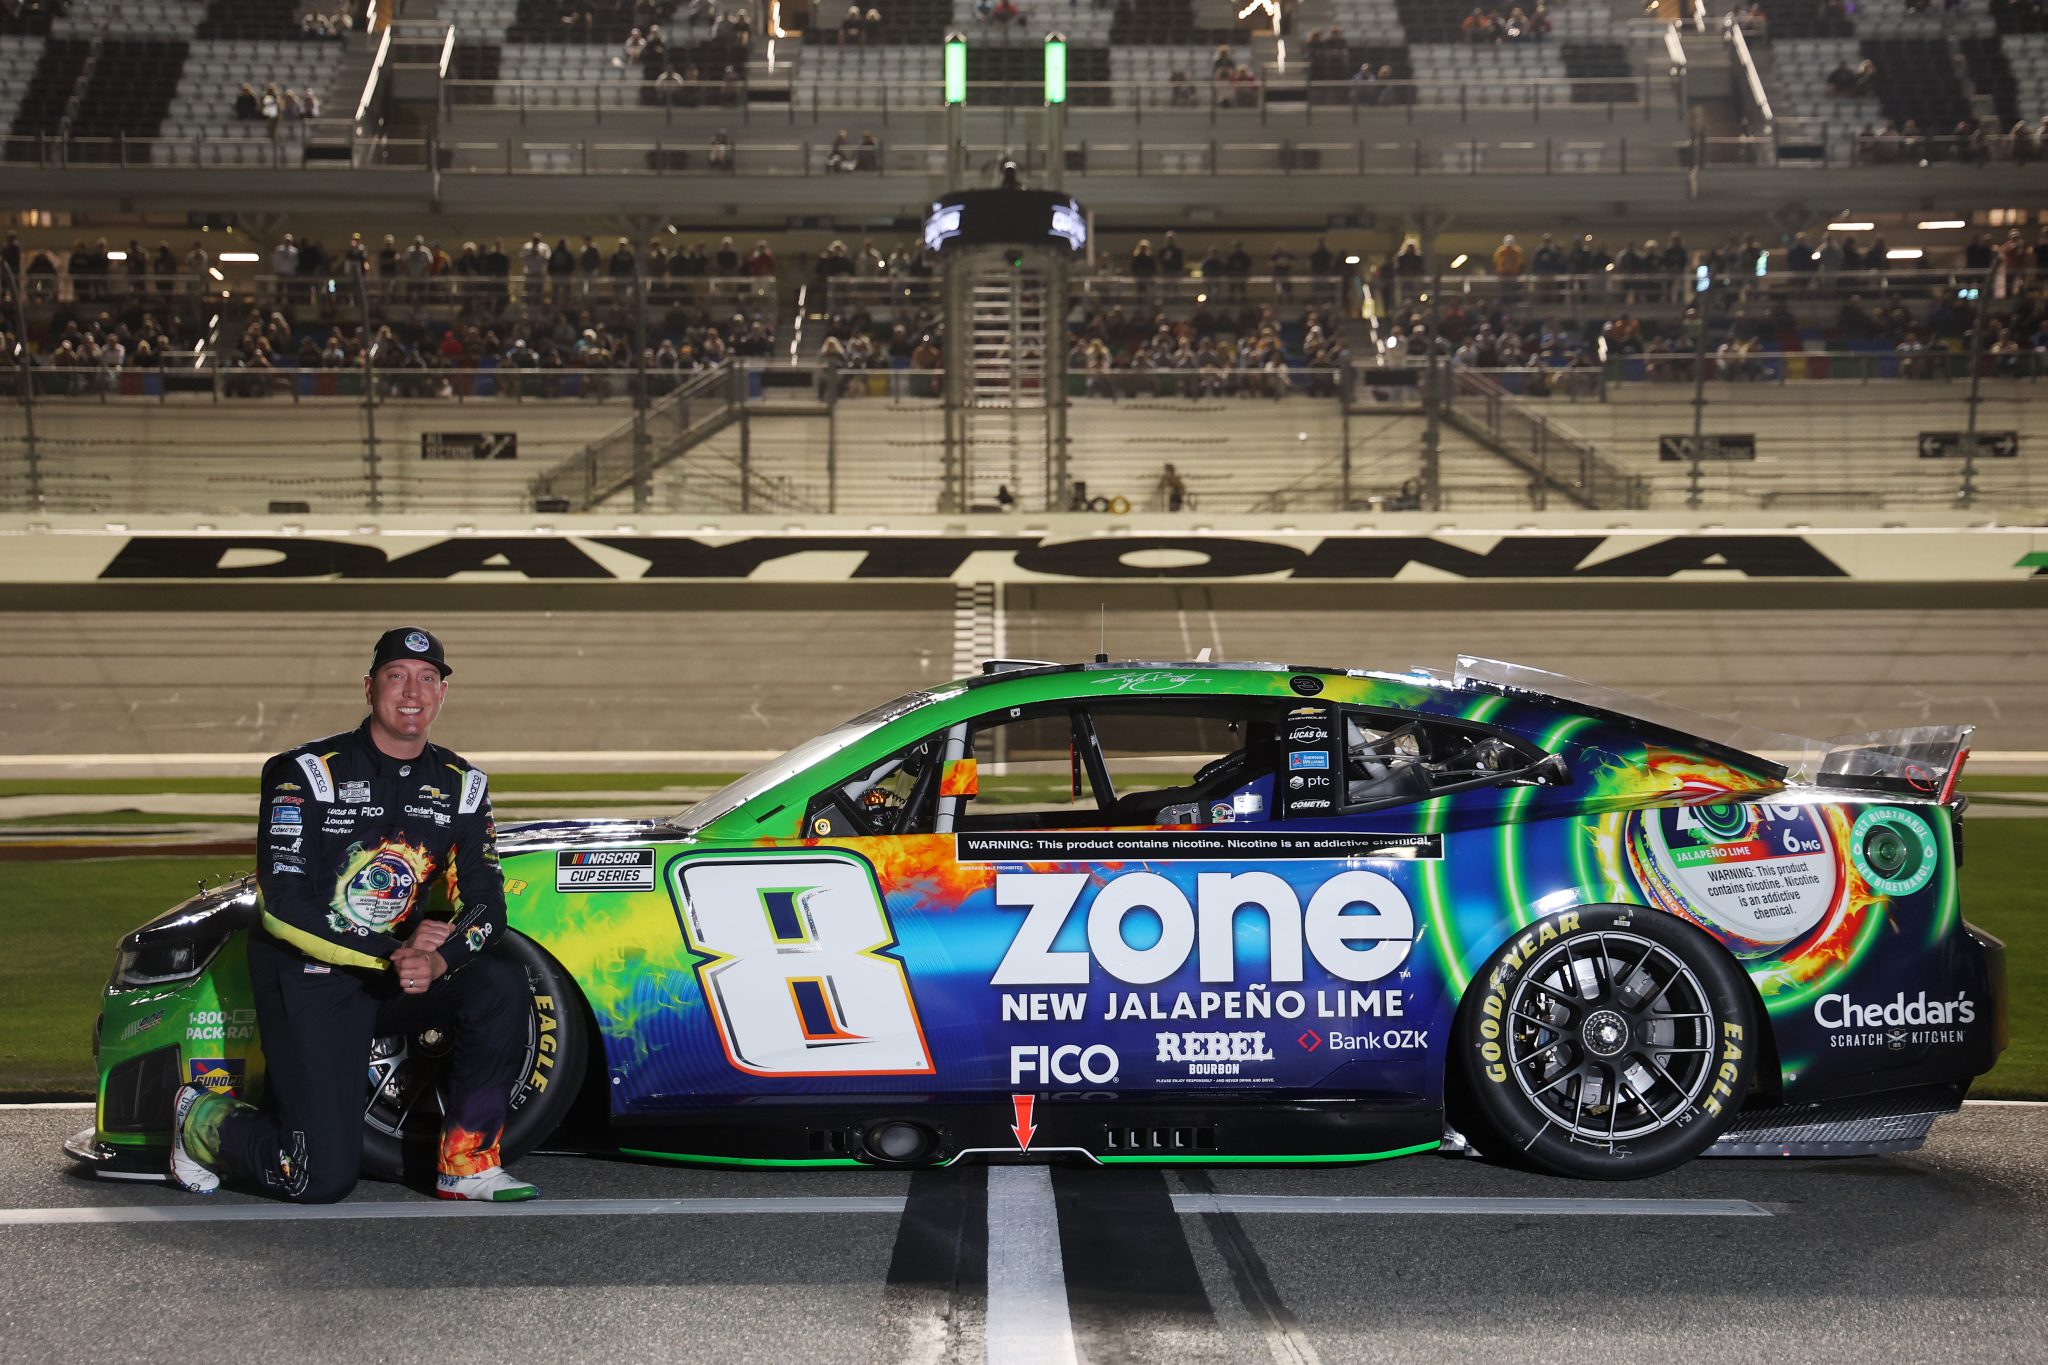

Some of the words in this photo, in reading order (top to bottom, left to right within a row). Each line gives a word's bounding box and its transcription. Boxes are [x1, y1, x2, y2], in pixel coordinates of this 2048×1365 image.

[98, 536, 1852, 579] DAYTONA
[1289, 731, 1314, 740] LUCAS
[305, 758, 328, 793] sparco
[1307, 775, 1330, 788] ptc
[465, 774, 481, 807] sparco
[361, 806, 384, 817] FICO
[1290, 799, 1331, 809] COMETIC
[1854, 819, 1870, 837] GET
[1868, 810, 1928, 839] BIOETHANOL
[968, 840, 1034, 850] WARNING:
[1037, 840, 1063, 849] This
[1066, 839, 1114, 851] product
[1117, 839, 1169, 849] contains
[1172, 839, 1224, 849] nicotine.
[1228, 839, 1278, 848] Nicotine
[1281, 839, 1292, 848] is
[1313, 839, 1369, 848] addictive
[1782, 828, 1801, 853] 6
[1801, 839, 1821, 851] MG
[587, 852, 641, 864] NASCAR
[1676, 847, 1727, 862] JALAPEÑO
[1727, 846, 1751, 857] LIME
[570, 870, 596, 882] CUP
[597, 869, 641, 882] SERIES
[1708, 867, 1756, 882] WARNING:
[1758, 865, 1777, 877] This
[1778, 861, 1809, 878] product
[1857, 863, 1873, 880] GET
[1873, 864, 1931, 892] BIOETHANOL
[1707, 883, 1745, 897] contains
[1746, 879, 1782, 892] nicotine.
[1784, 874, 1820, 887] Nicotine
[1739, 895, 1748, 907] is
[1749, 897, 1761, 906] an
[1762, 890, 1801, 905] addictive
[1754, 904, 1797, 920] chemical.
[990, 870, 1414, 984] zone
[663, 846, 937, 1078] 8
[1002, 993, 1088, 1021] NEW
[1104, 983, 1306, 1021] JALAPEÑO
[1317, 989, 1404, 1018] LIME
[1814, 990, 1976, 1029] Cheddar's
[530, 994, 557, 1095] EAGLE
[1155, 1030, 1274, 1063] REBEL
[1329, 1031, 1381, 1050] Bank
[1383, 1030, 1428, 1049] OZK
[1830, 1033, 1883, 1048] SCRATCH
[1911, 1030, 1965, 1044] KITCHEN
[1010, 1044, 1119, 1084] FICO
[1188, 1063, 1240, 1075] BOURBON
[1702, 1021, 1743, 1119] EAGLE
[196, 1076, 243, 1087] SUNOCO
